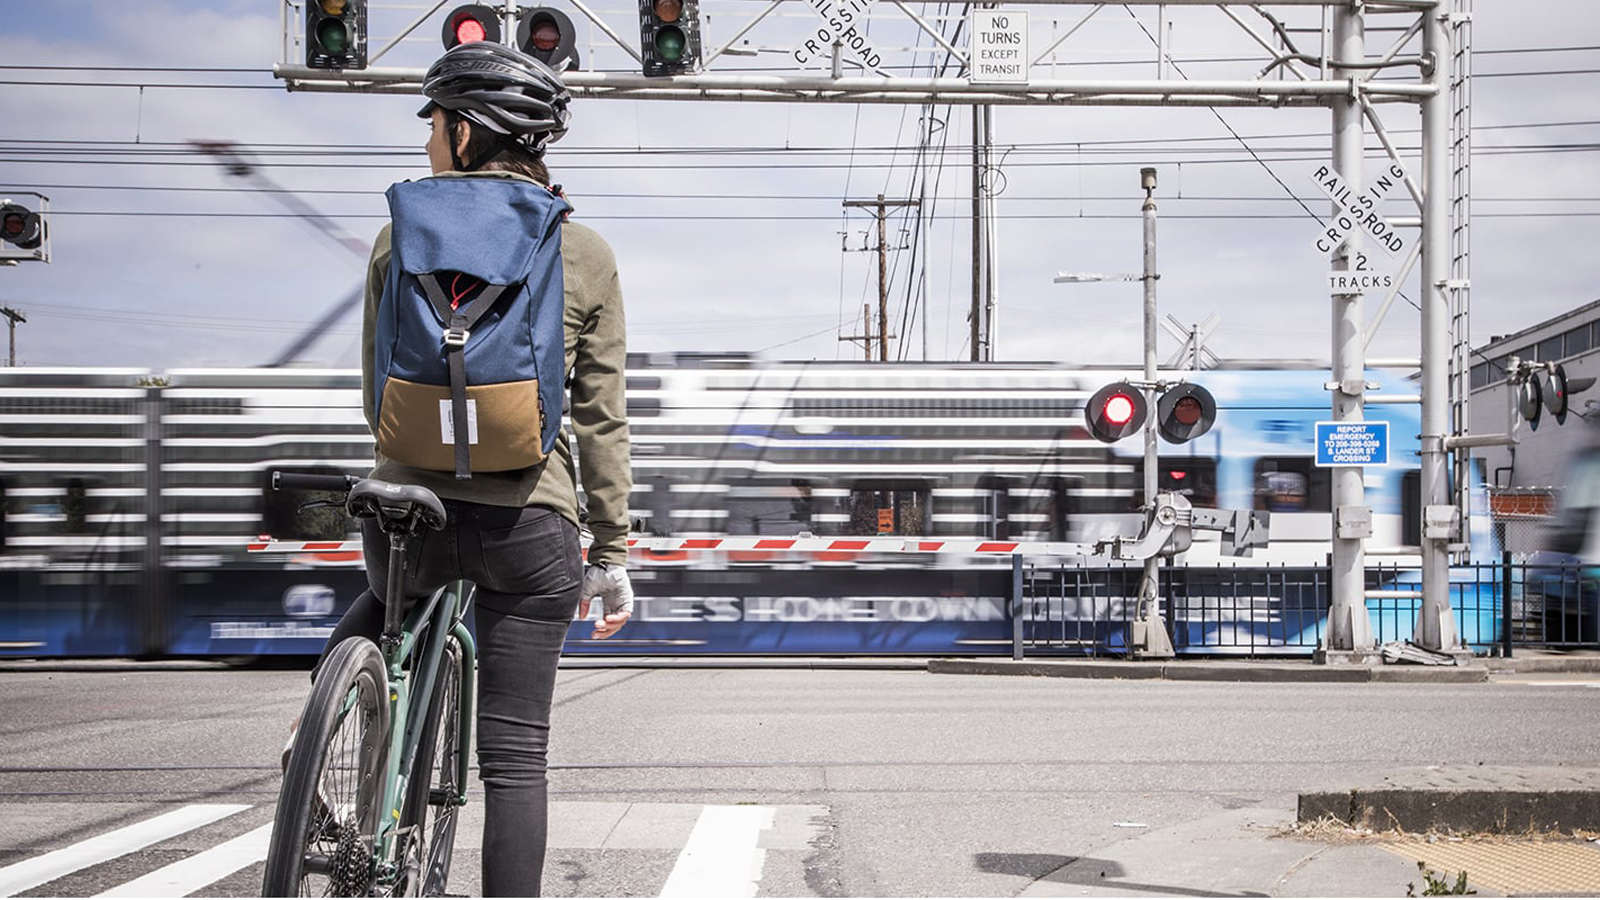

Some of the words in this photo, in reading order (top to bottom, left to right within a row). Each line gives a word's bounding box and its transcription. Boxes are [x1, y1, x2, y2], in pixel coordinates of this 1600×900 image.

[992, 16, 1009, 29] NO
[980, 32, 1021, 45] TURNS
[981, 49, 1019, 59] EXCEPT
[980, 64, 1021, 75] TRANSIT
[1313, 166, 1403, 252] RAILROAD
[1316, 164, 1404, 253] CROSSING
[1329, 275, 1392, 288] TRACKS
[1335, 447, 1365, 455] LANDER
